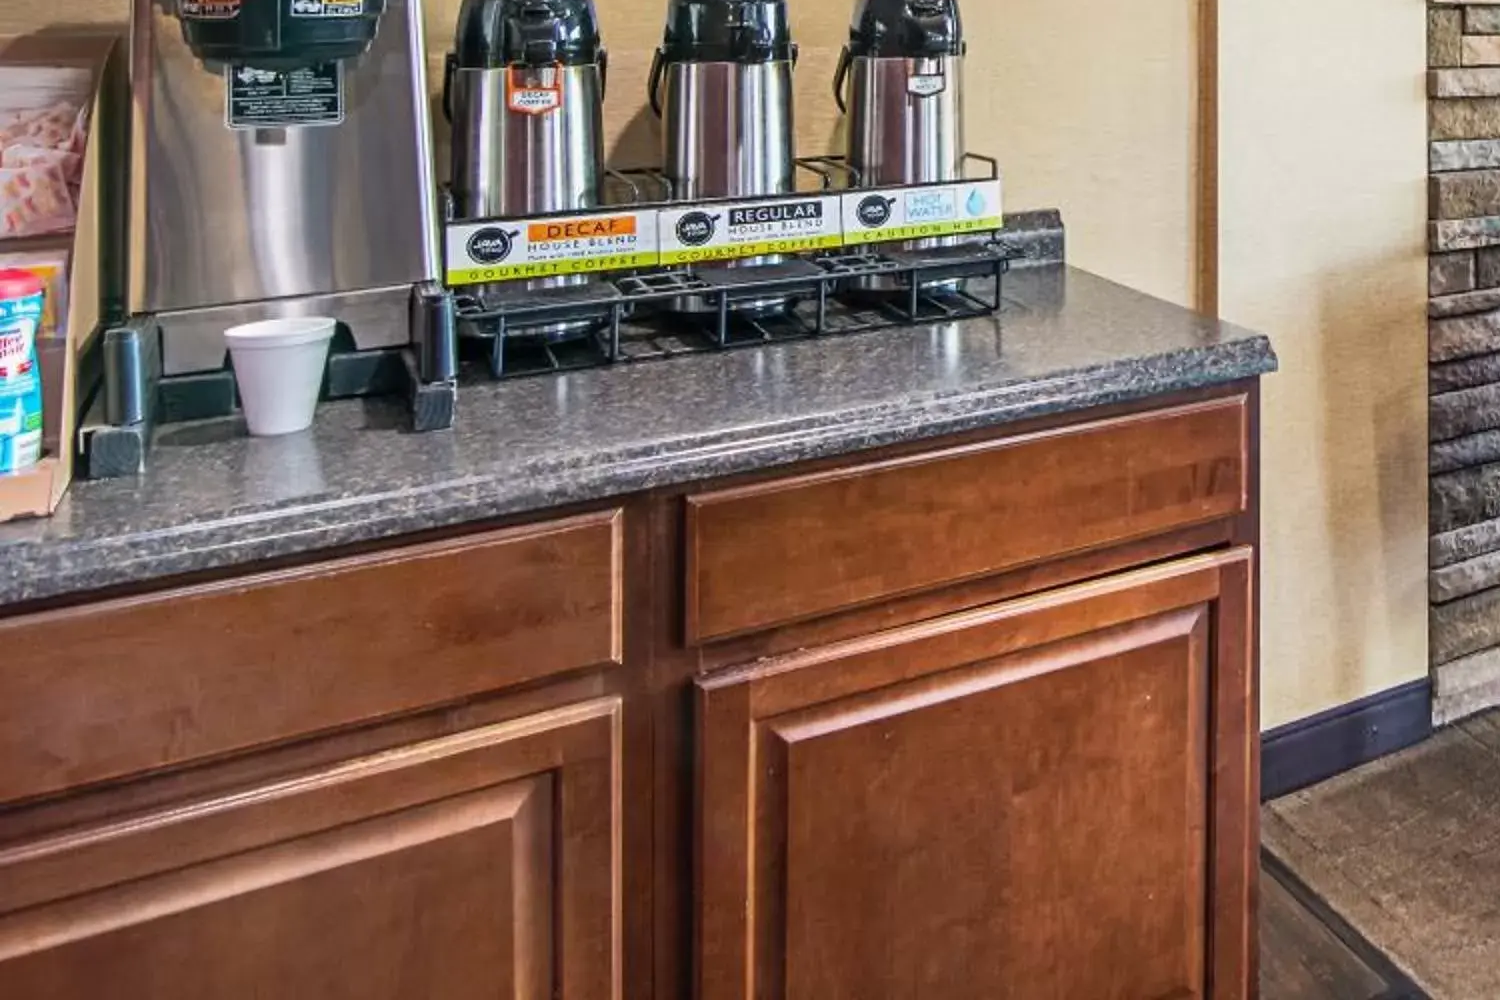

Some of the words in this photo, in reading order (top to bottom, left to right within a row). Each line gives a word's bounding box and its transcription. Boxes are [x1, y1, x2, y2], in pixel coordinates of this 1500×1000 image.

[733, 203, 818, 224] REGULAR
[546, 220, 616, 239] DECAF
[727, 224, 774, 236] HOUSE
[781, 219, 824, 231] BLEND
[863, 224, 943, 240] CAUTION
[953, 220, 984, 230] HOT
[527, 242, 579, 253] HOUSE
[589, 235, 638, 247] BLEND
[676, 245, 757, 261] GOURMET
[766, 237, 828, 252] COFFEE
[469, 263, 559, 281] GOURMET
[571, 256, 638, 271] COFFEE
